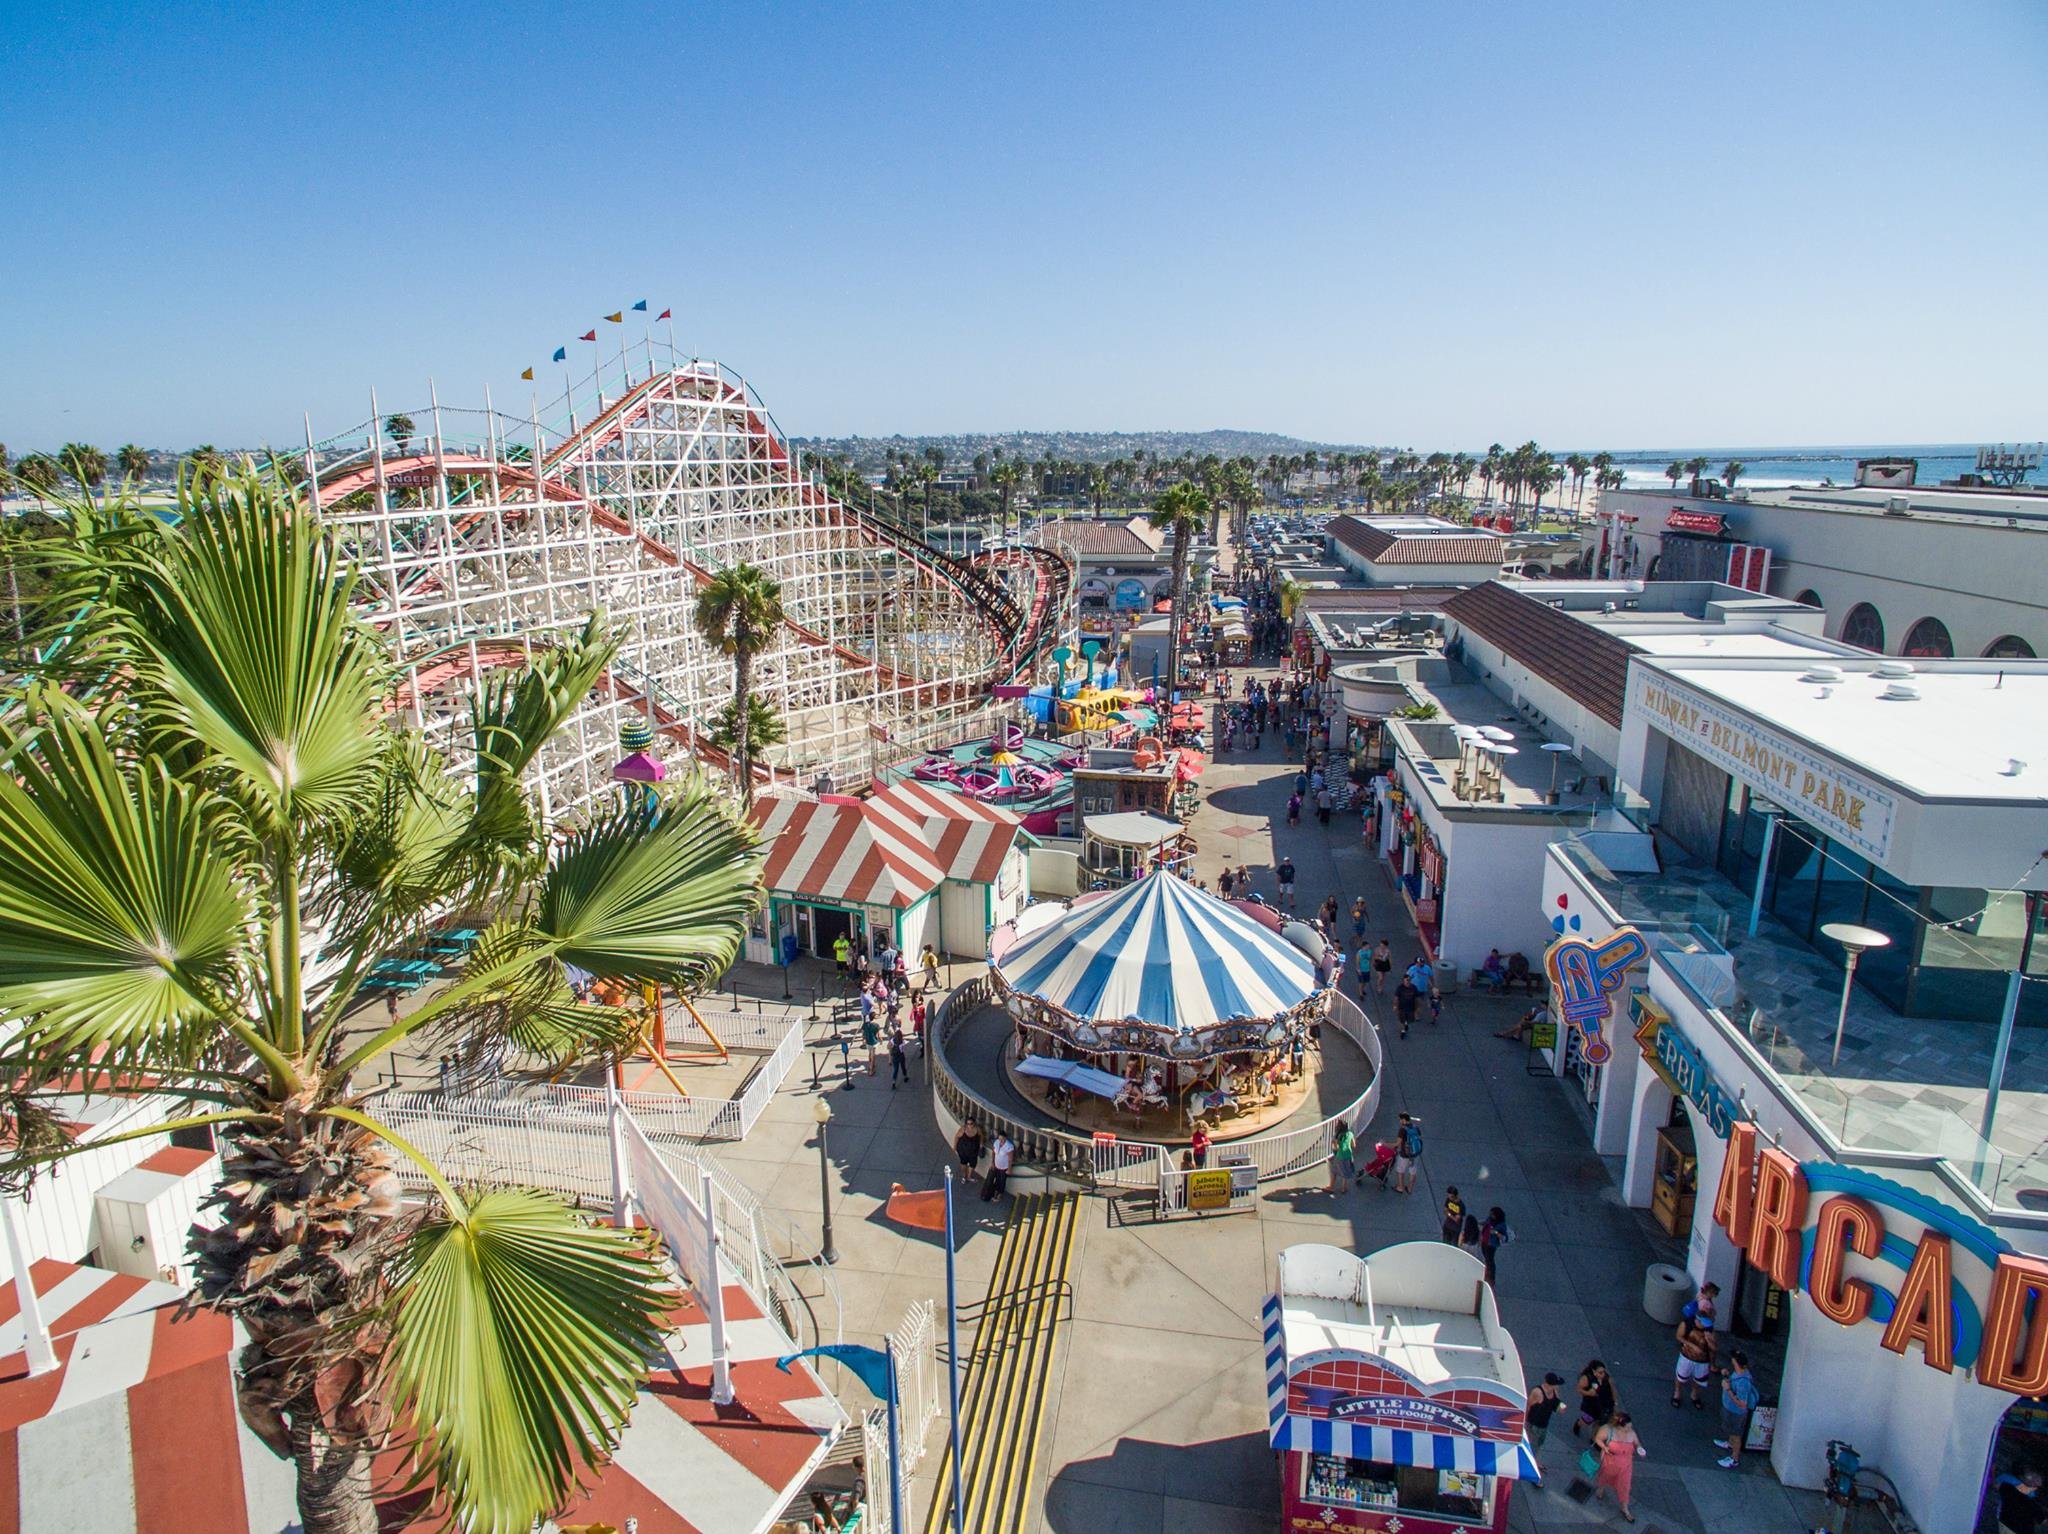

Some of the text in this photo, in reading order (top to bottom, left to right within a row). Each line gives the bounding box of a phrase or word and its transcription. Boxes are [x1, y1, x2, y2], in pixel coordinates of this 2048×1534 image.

[386, 475, 430, 483] ANGER
[1644, 686, 1700, 733] MIDWAY
[1710, 720, 1797, 789] BELMONT
[1801, 769, 1866, 831] PARK
[1335, 1399, 1478, 1434] LITTLE DIPPER
[1376, 1408, 1434, 1421] FUN FOODS
